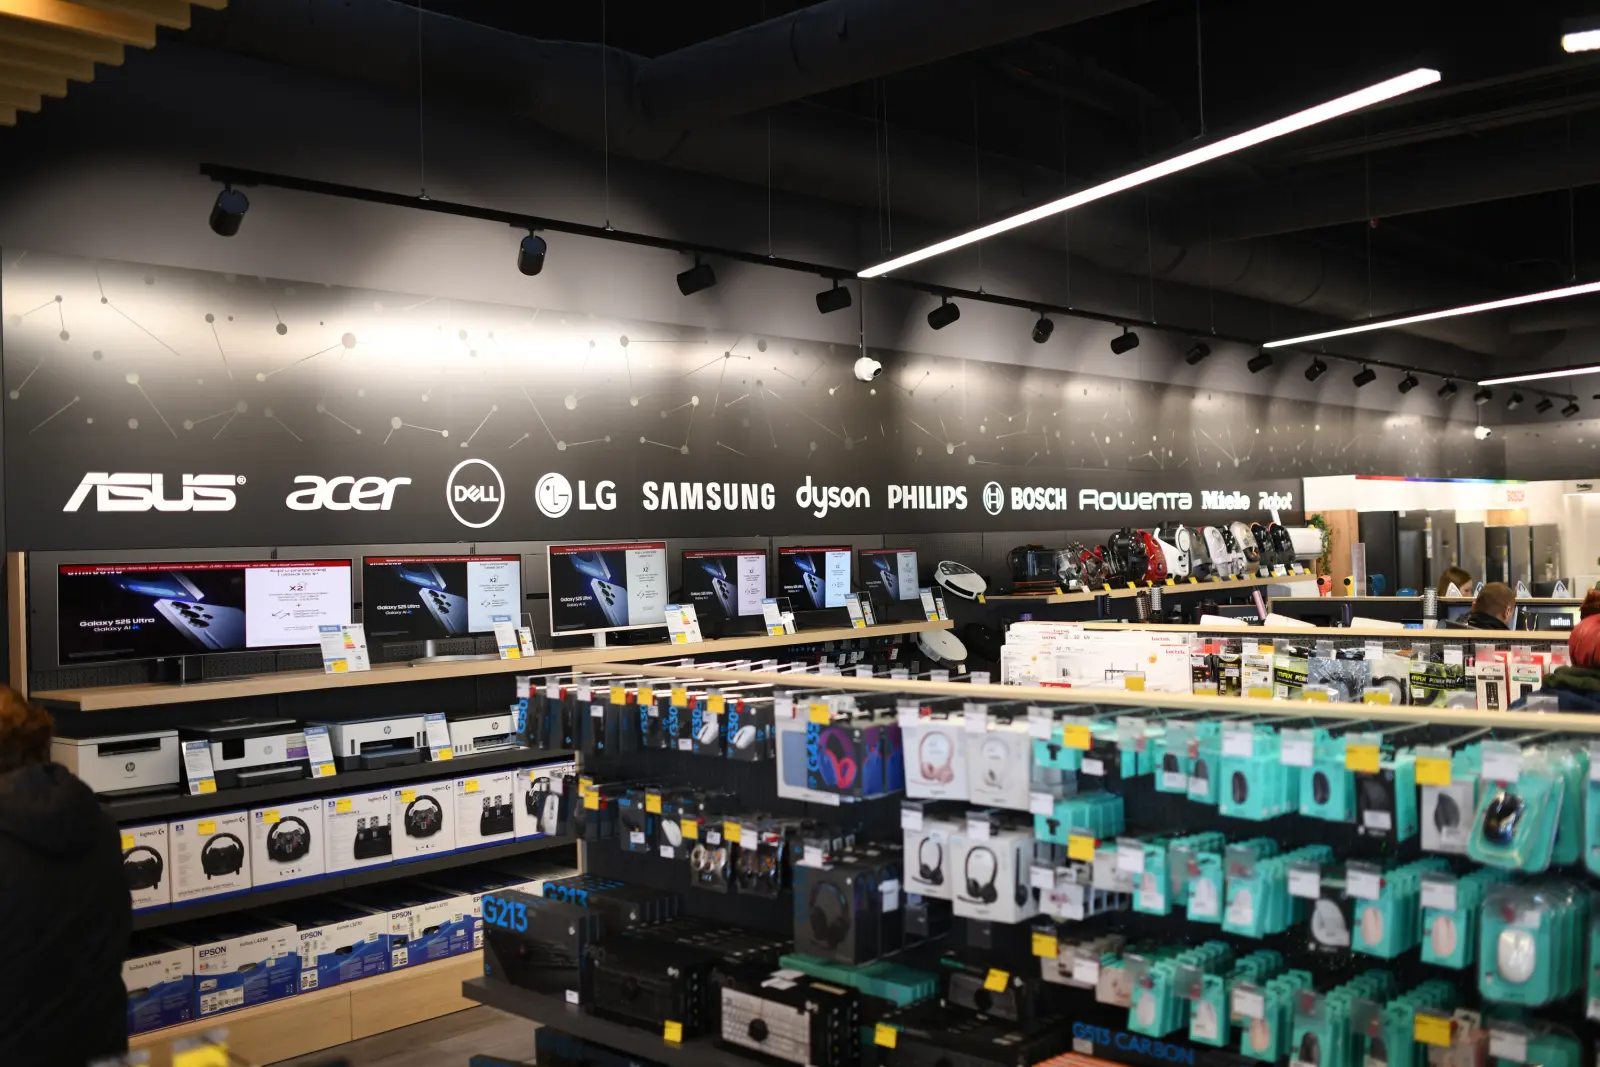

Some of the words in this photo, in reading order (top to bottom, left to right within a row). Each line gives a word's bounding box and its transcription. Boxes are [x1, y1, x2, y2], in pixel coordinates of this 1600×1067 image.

[286, 475, 412, 511] acer
[454, 485, 499, 502] DELL
[578, 480, 617, 510] LG
[642, 480, 776, 510] SAMSUNG
[795, 475, 871, 519] dyson
[887, 484, 967, 510] PHILIPS
[1010, 486, 1067, 510] BOSCH
[1201, 490, 1251, 511] Miele
[392, 910, 412, 920] EPSON
[482, 895, 528, 933] G213
[300, 930, 323, 940] EPSON
[199, 946, 227, 958] EPSON
[1114, 1032, 1195, 1065] CARBON
